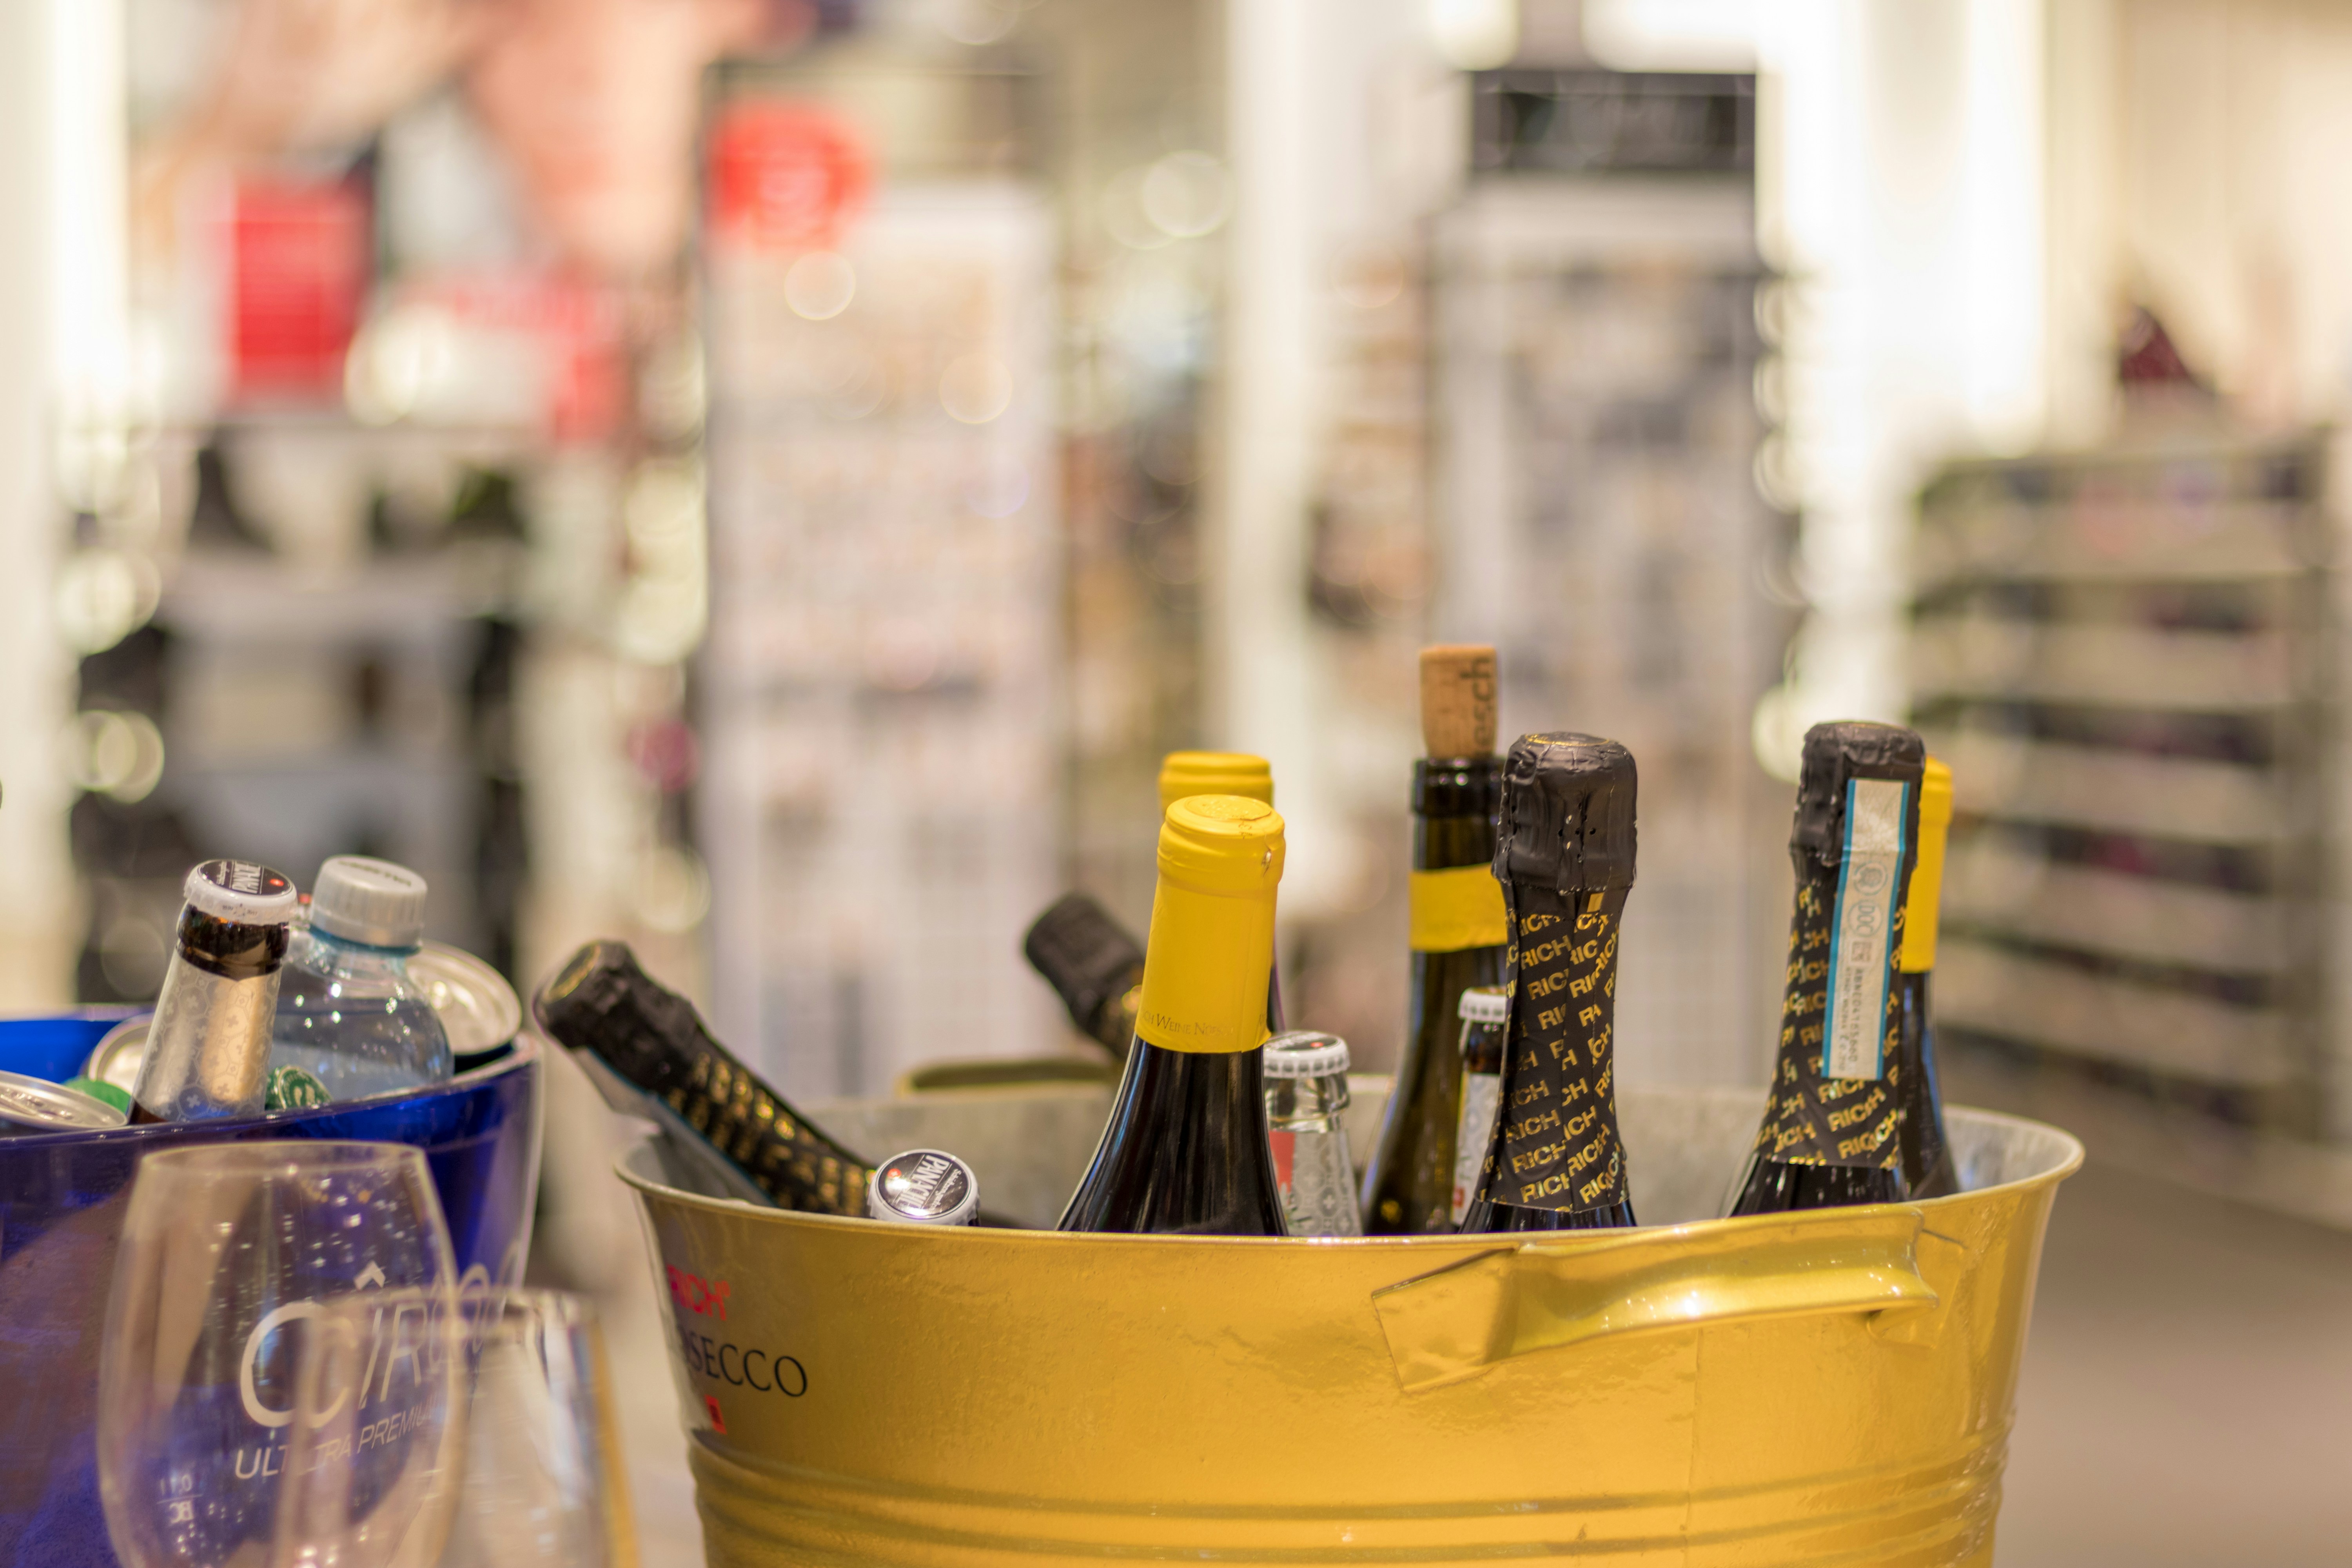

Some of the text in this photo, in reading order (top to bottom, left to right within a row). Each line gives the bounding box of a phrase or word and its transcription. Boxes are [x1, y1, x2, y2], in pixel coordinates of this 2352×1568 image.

[1857, 905, 1875, 932] DOC
[1521, 935, 1572, 971] RICH
[1570, 940, 1598, 965] RIC
[1563, 1105, 1597, 1141] ICH
[1512, 1139, 1567, 1173] RICH
[684, 1330, 808, 1398] SECCO
